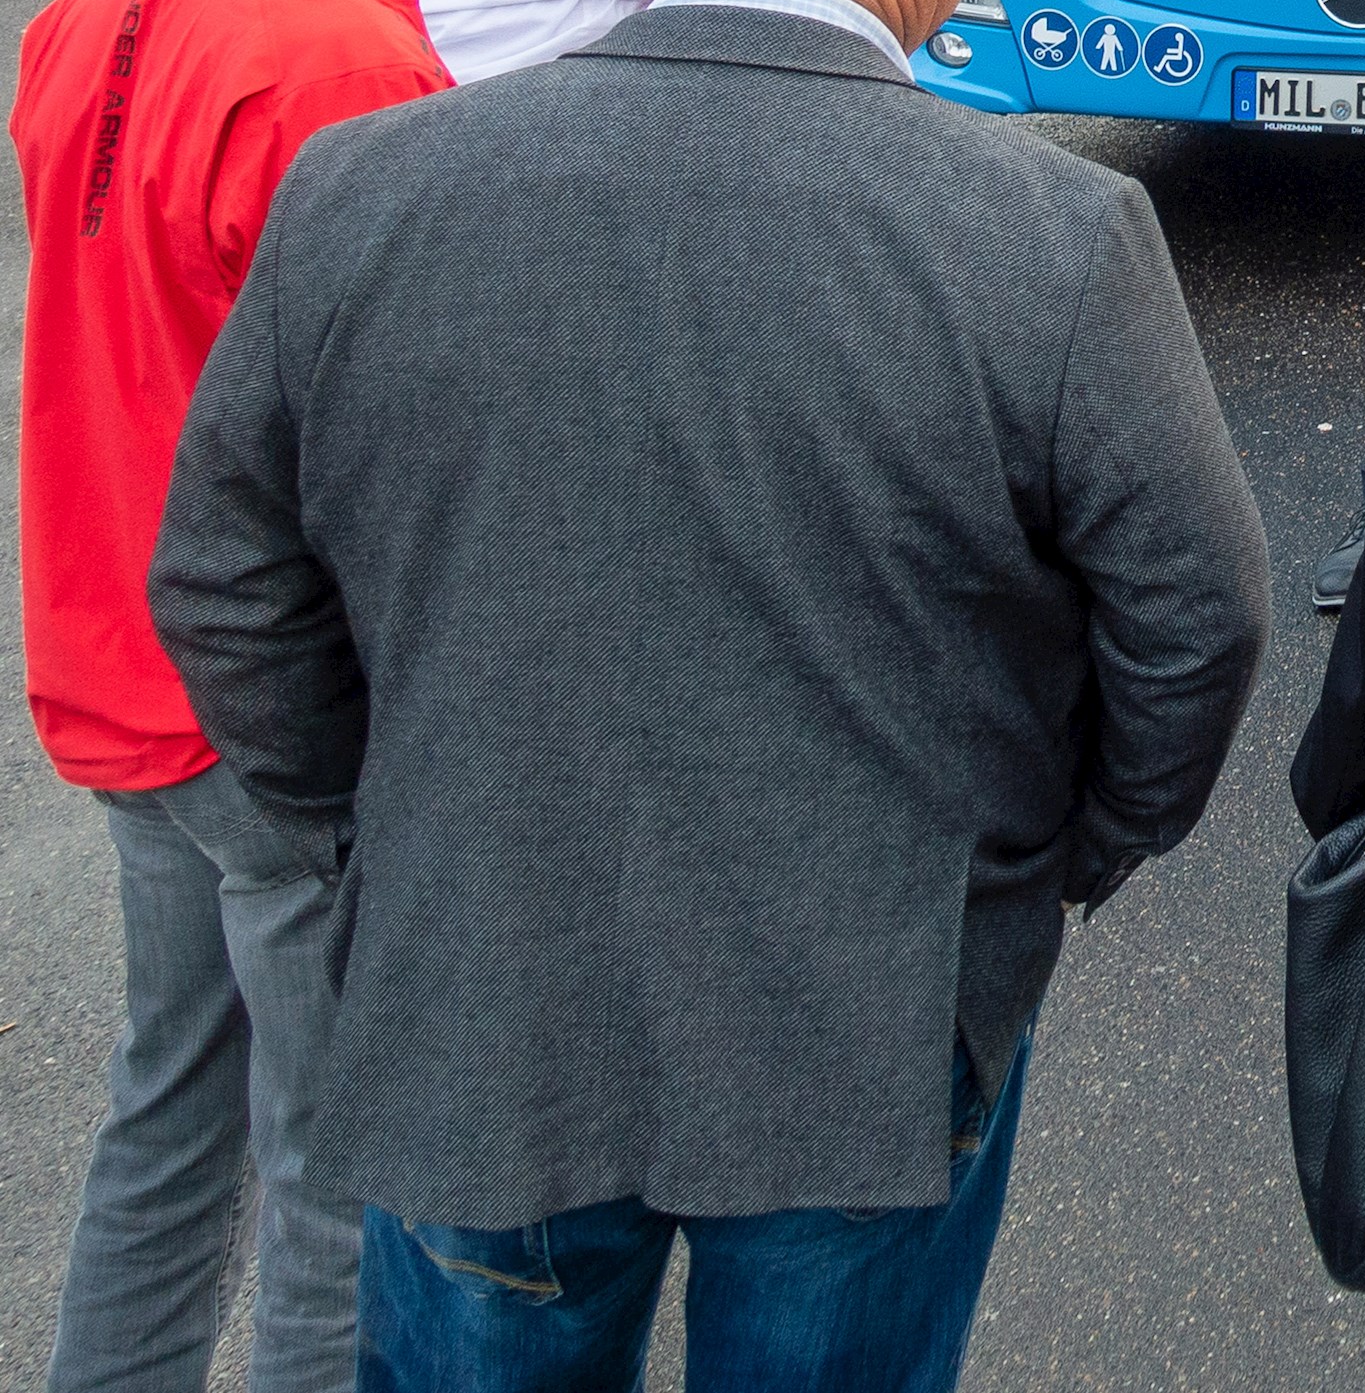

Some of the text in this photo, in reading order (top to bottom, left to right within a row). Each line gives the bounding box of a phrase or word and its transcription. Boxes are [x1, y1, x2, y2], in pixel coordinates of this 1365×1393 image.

[1259, 78, 1326, 118] MIL
[1264, 122, 1323, 133] KUNZMANN
[80, 89, 125, 238] ARMOUR
